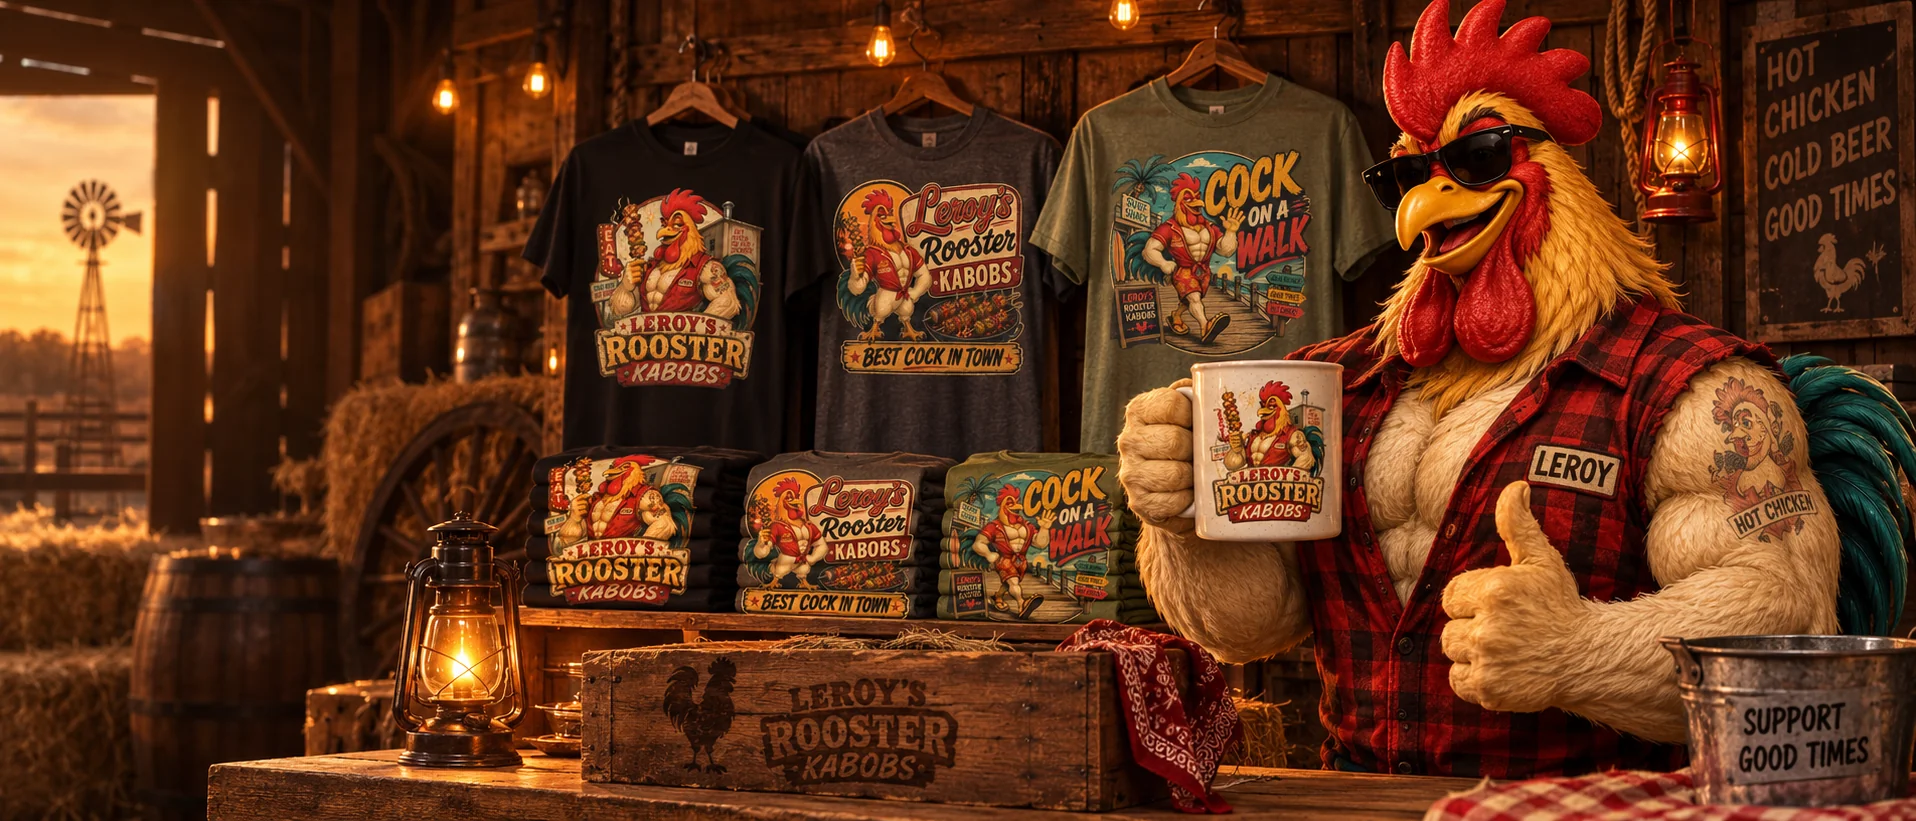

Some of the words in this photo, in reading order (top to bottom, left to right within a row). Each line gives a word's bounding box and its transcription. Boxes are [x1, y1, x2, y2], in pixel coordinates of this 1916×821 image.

[1766, 40, 1820, 91] HOT
[1764, 66, 1876, 139] CHICKEN
[1764, 141, 1822, 190] COLD
[1830, 116, 1892, 168] BEER
[1204, 150, 1304, 217] COCK
[907, 183, 1013, 237] Leroy's
[1247, 203, 1272, 227] ON
[1276, 200, 1289, 219] A
[1764, 193, 1823, 242] GOOD
[1829, 169, 1896, 221] TIMES
[604, 229, 615, 267] EAT
[920, 228, 1016, 266] Rooster
[1237, 214, 1310, 270] WALK
[939, 261, 1012, 292] KABOBS
[629, 315, 717, 335] LEROY'S
[603, 334, 744, 370] ROOSTER
[862, 347, 902, 368] BEST
[903, 347, 943, 367] COCK
[947, 347, 962, 366] IN
[965, 347, 1005, 368] TOWN
[631, 362, 721, 384] KABOBS
[1239, 468, 1301, 482] LEROY'S
[1535, 450, 1615, 488] LEROY
[554, 471, 563, 503] EAT
[809, 476, 907, 518] Leroy's
[1023, 466, 1107, 517] COCK
[1219, 482, 1319, 510] ROOSTER
[820, 514, 907, 540] Rooster
[1058, 505, 1081, 525] ON
[1084, 503, 1095, 519] A
[1239, 503, 1303, 520] KABOBS
[1734, 508, 1765, 535] HOT
[1765, 493, 1814, 521] CHICKEN
[576, 540, 655, 559] LEROY'S
[834, 540, 901, 561] KABOBS
[1050, 514, 1113, 560] WALK
[554, 557, 683, 588] ROOSTER
[578, 583, 658, 601] KABOBS
[761, 594, 798, 611] BEST
[800, 594, 838, 611] COCK
[839, 595, 854, 612] IN
[855, 596, 892, 613] TOWN
[788, 678, 927, 713] LEROY'S
[1743, 702, 1845, 735] SUPPORT
[765, 713, 952, 761] ROOSTER
[1739, 743, 1798, 772] GOOD
[1806, 736, 1869, 768] TIMES
[802, 752, 916, 780] KABOBS
